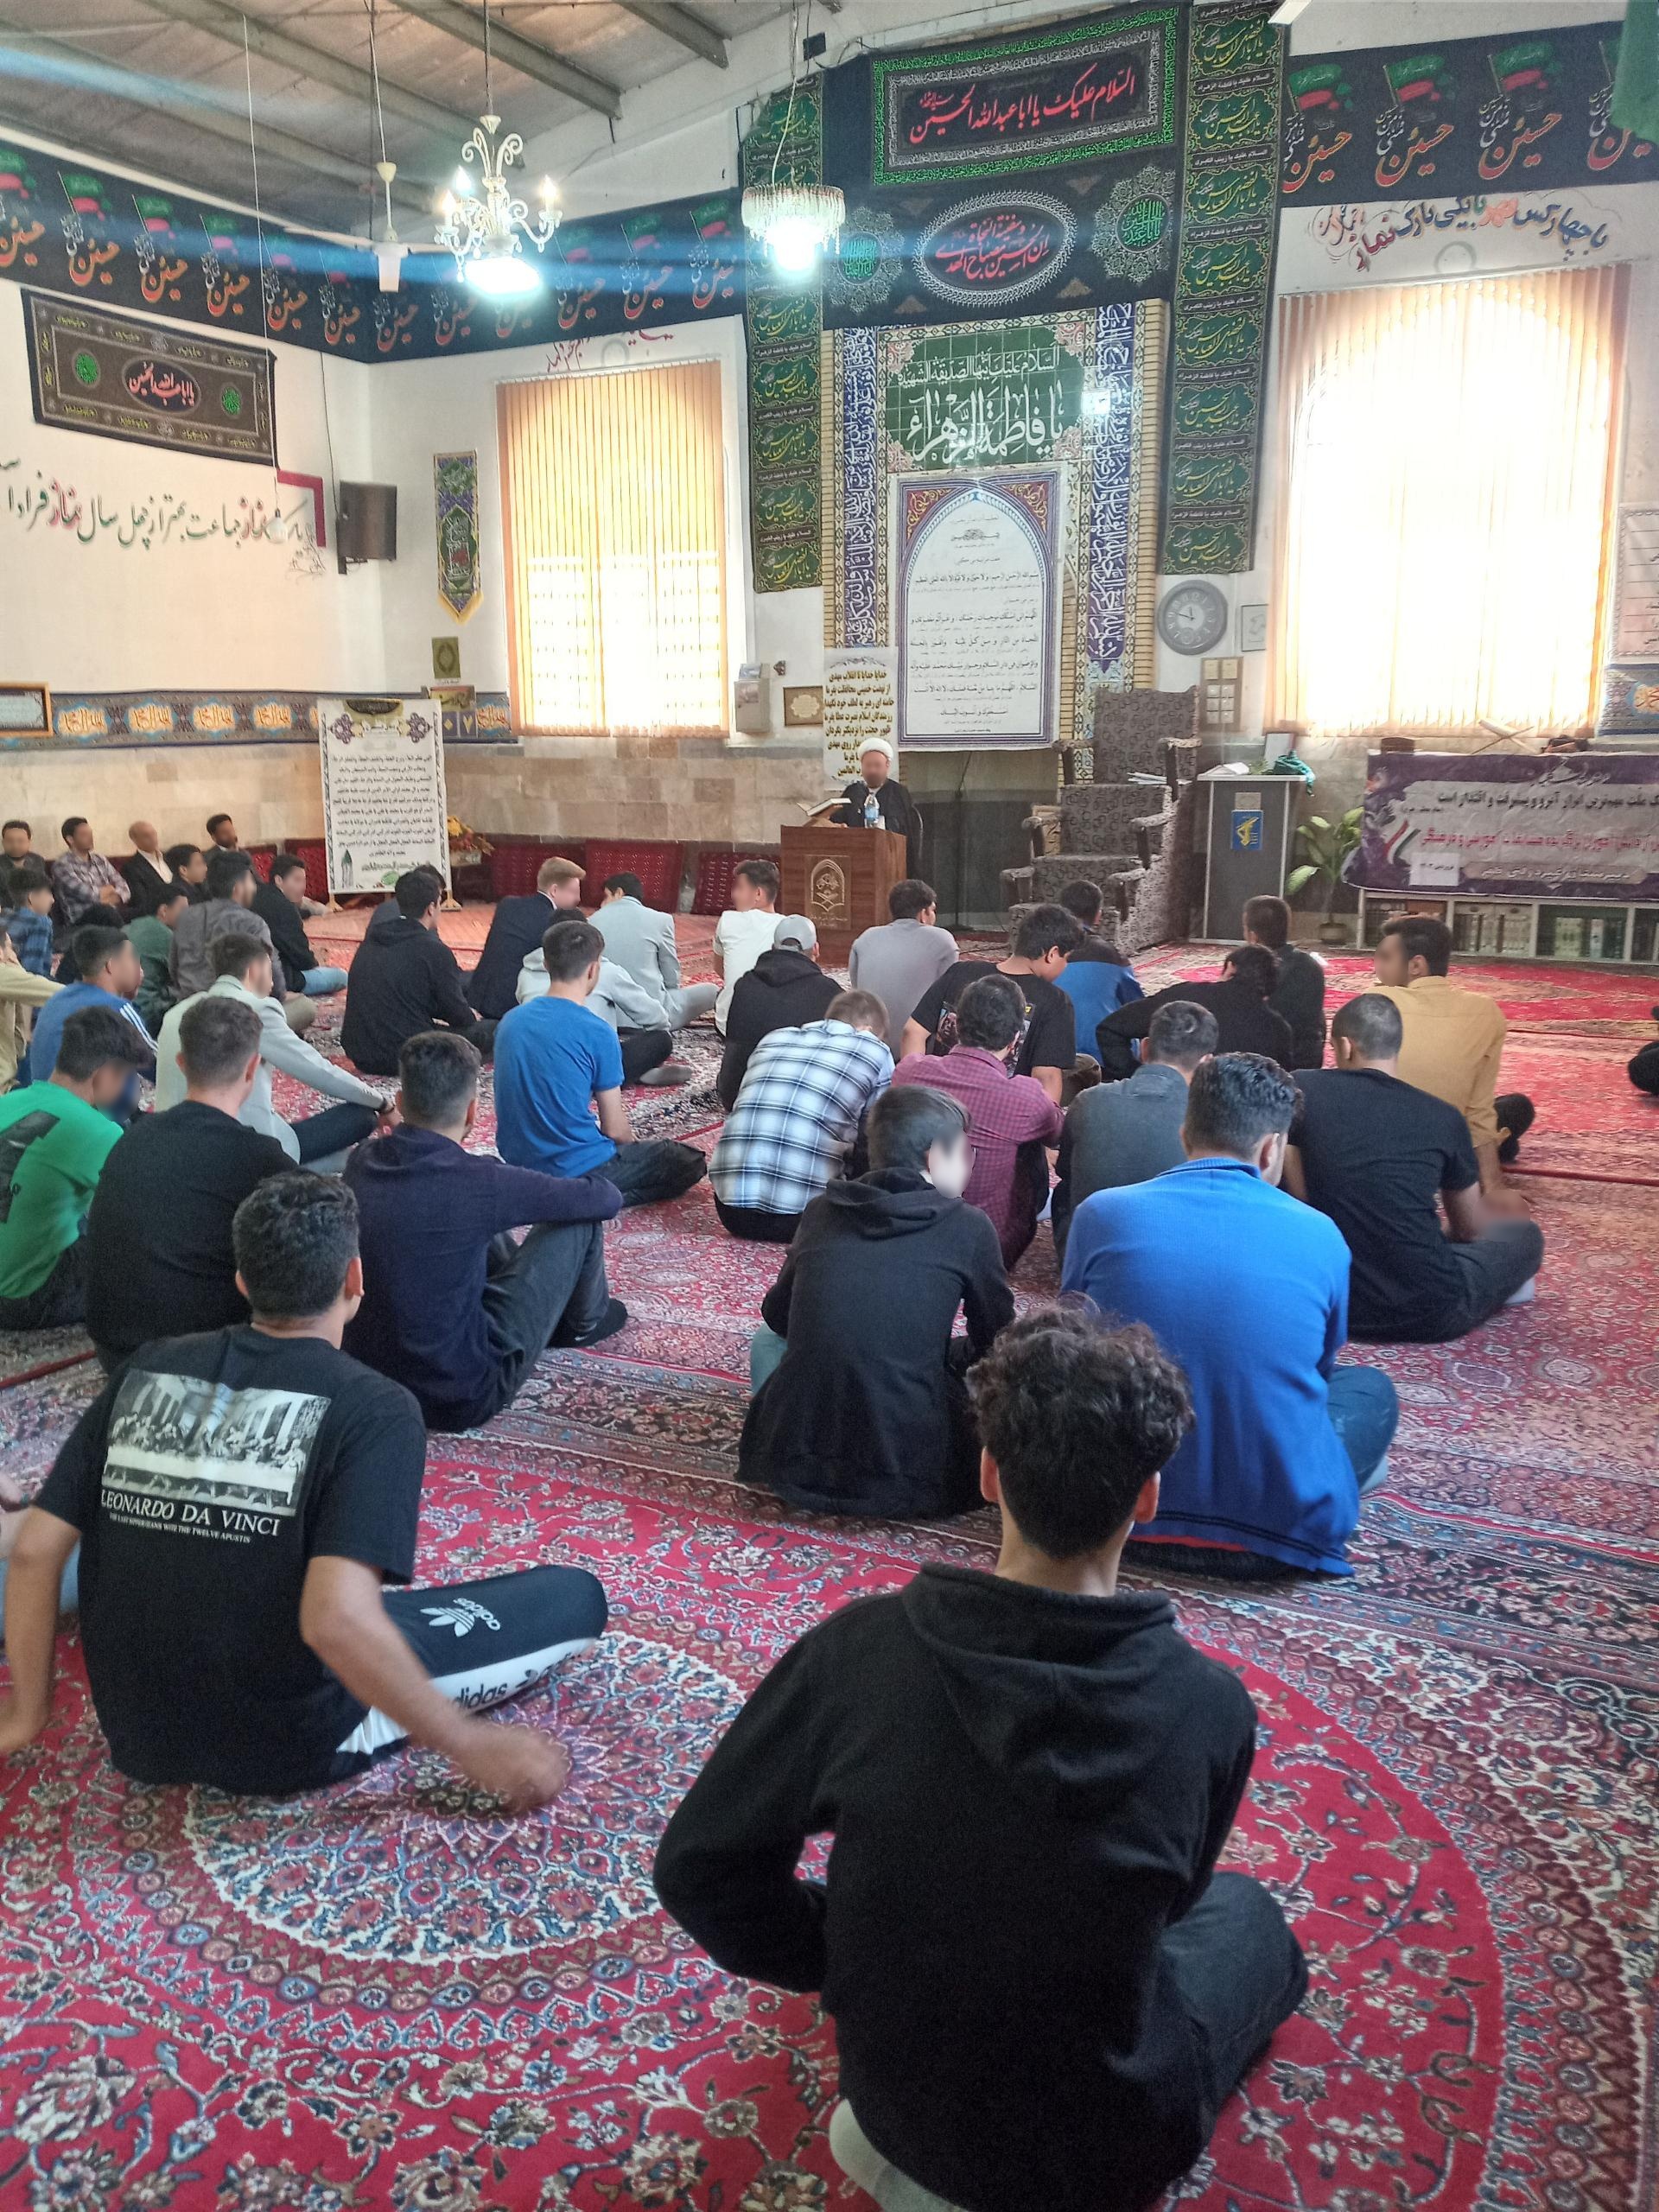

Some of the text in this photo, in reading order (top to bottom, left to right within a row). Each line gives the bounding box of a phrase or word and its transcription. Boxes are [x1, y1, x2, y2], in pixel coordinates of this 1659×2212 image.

[1375, 123, 1454, 188] حسین
[1478, 112, 1562, 181] حسین
[101, 1489, 175, 1521] LEONARDO
[181, 1503, 211, 1526] DA
[222, 1510, 281, 1537] VINCI
[454, 1682, 508, 1709] didas
